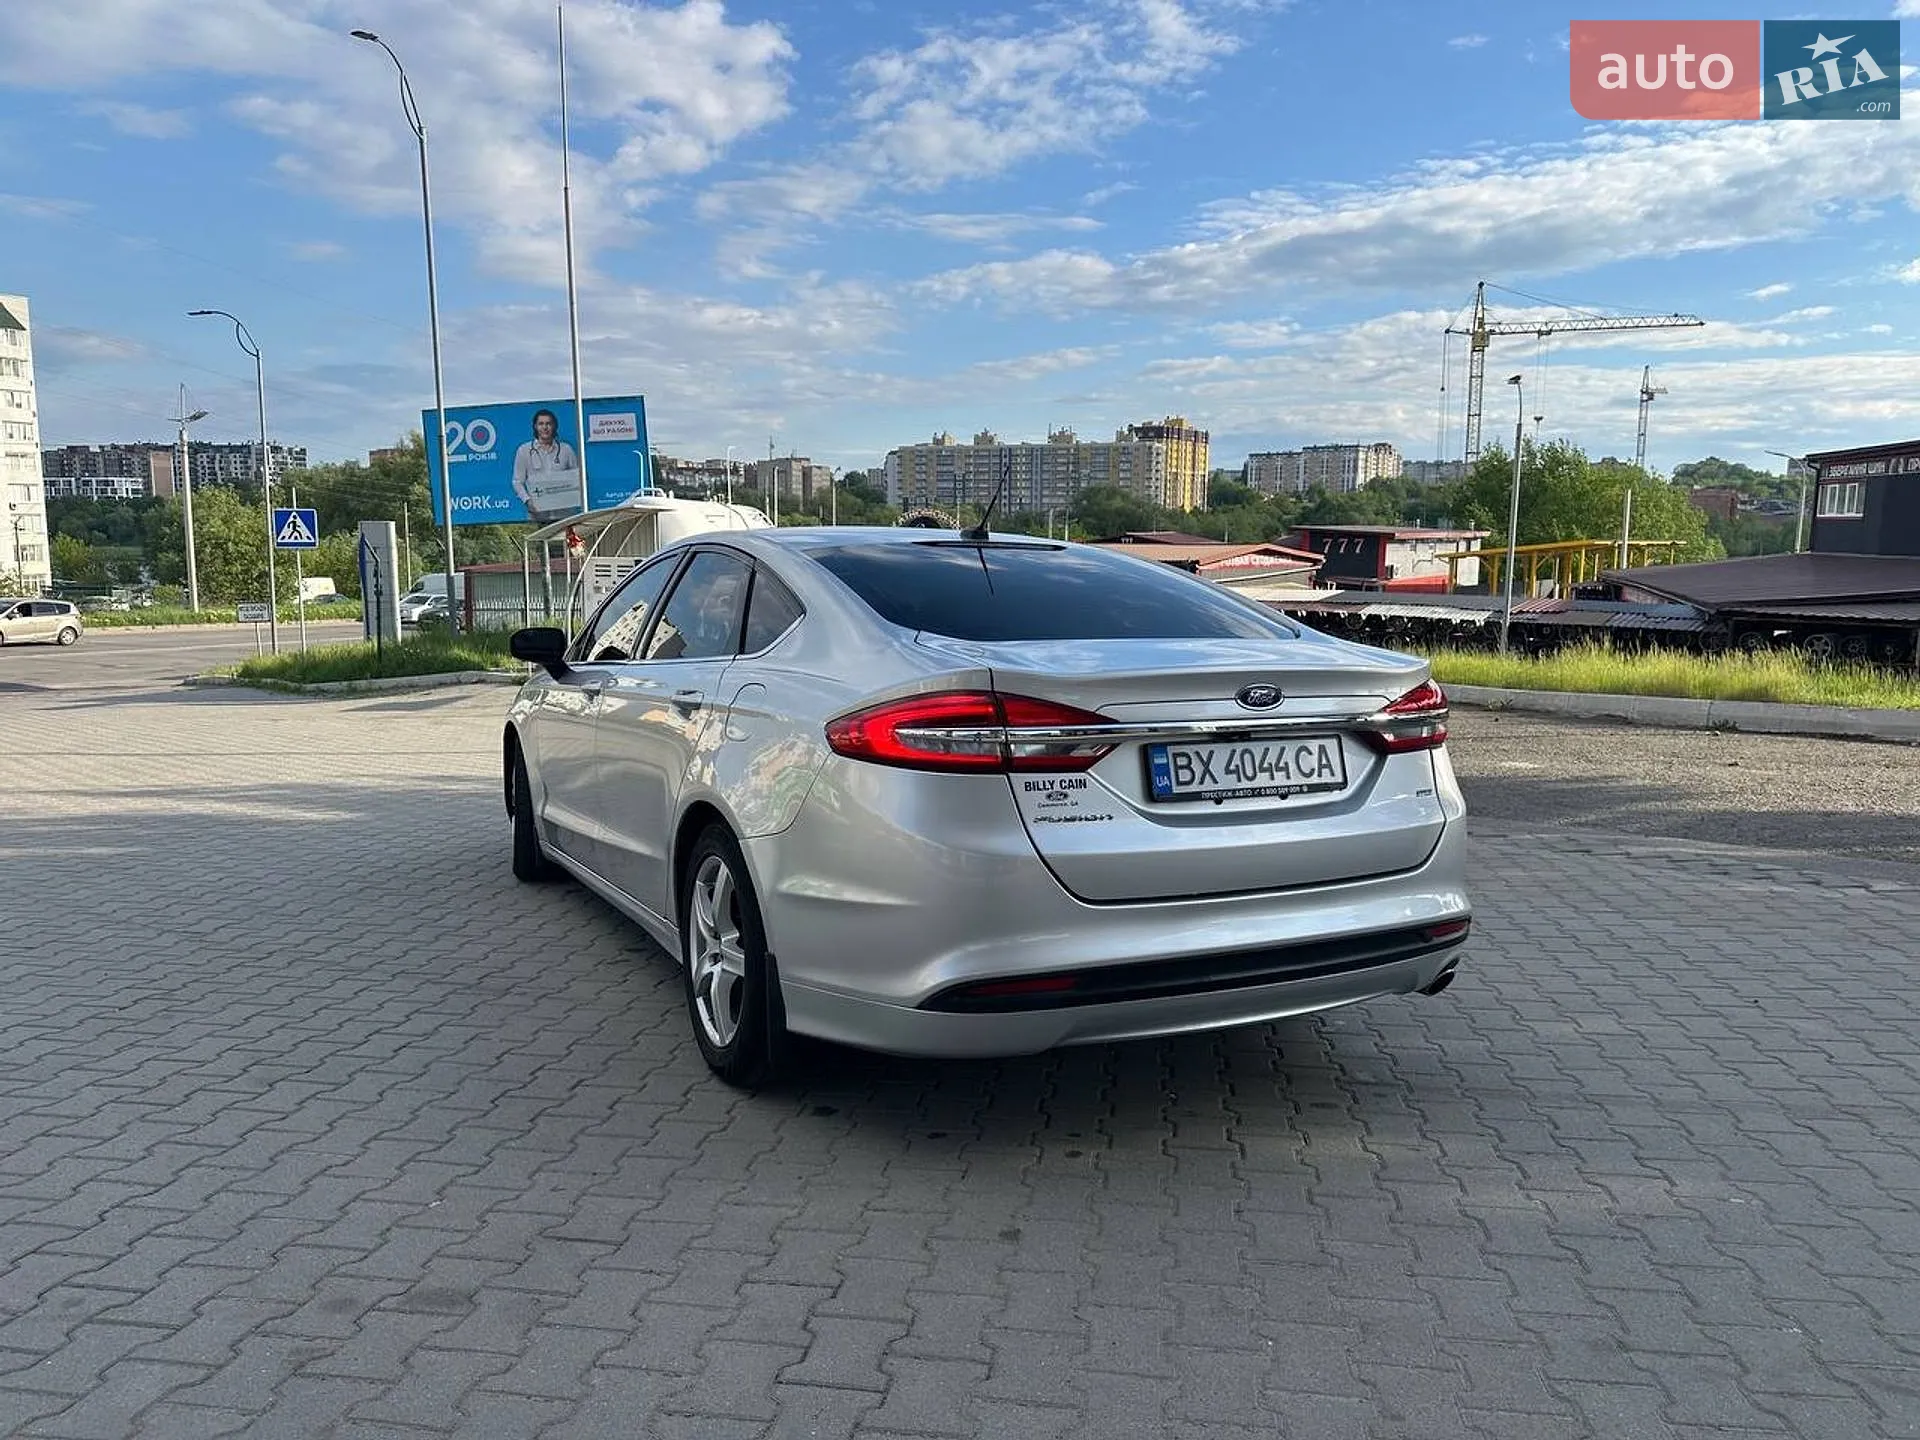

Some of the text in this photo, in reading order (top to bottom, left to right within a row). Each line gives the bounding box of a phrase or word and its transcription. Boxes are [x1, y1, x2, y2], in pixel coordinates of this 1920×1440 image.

[445, 418, 497, 462] 20
[468, 452, 498, 462] РОКІВ
[1173, 744, 1335, 786] BX 4044 CA
[1025, 779, 1087, 791] BILLY CAIN
[1156, 777, 1170, 788] UA
